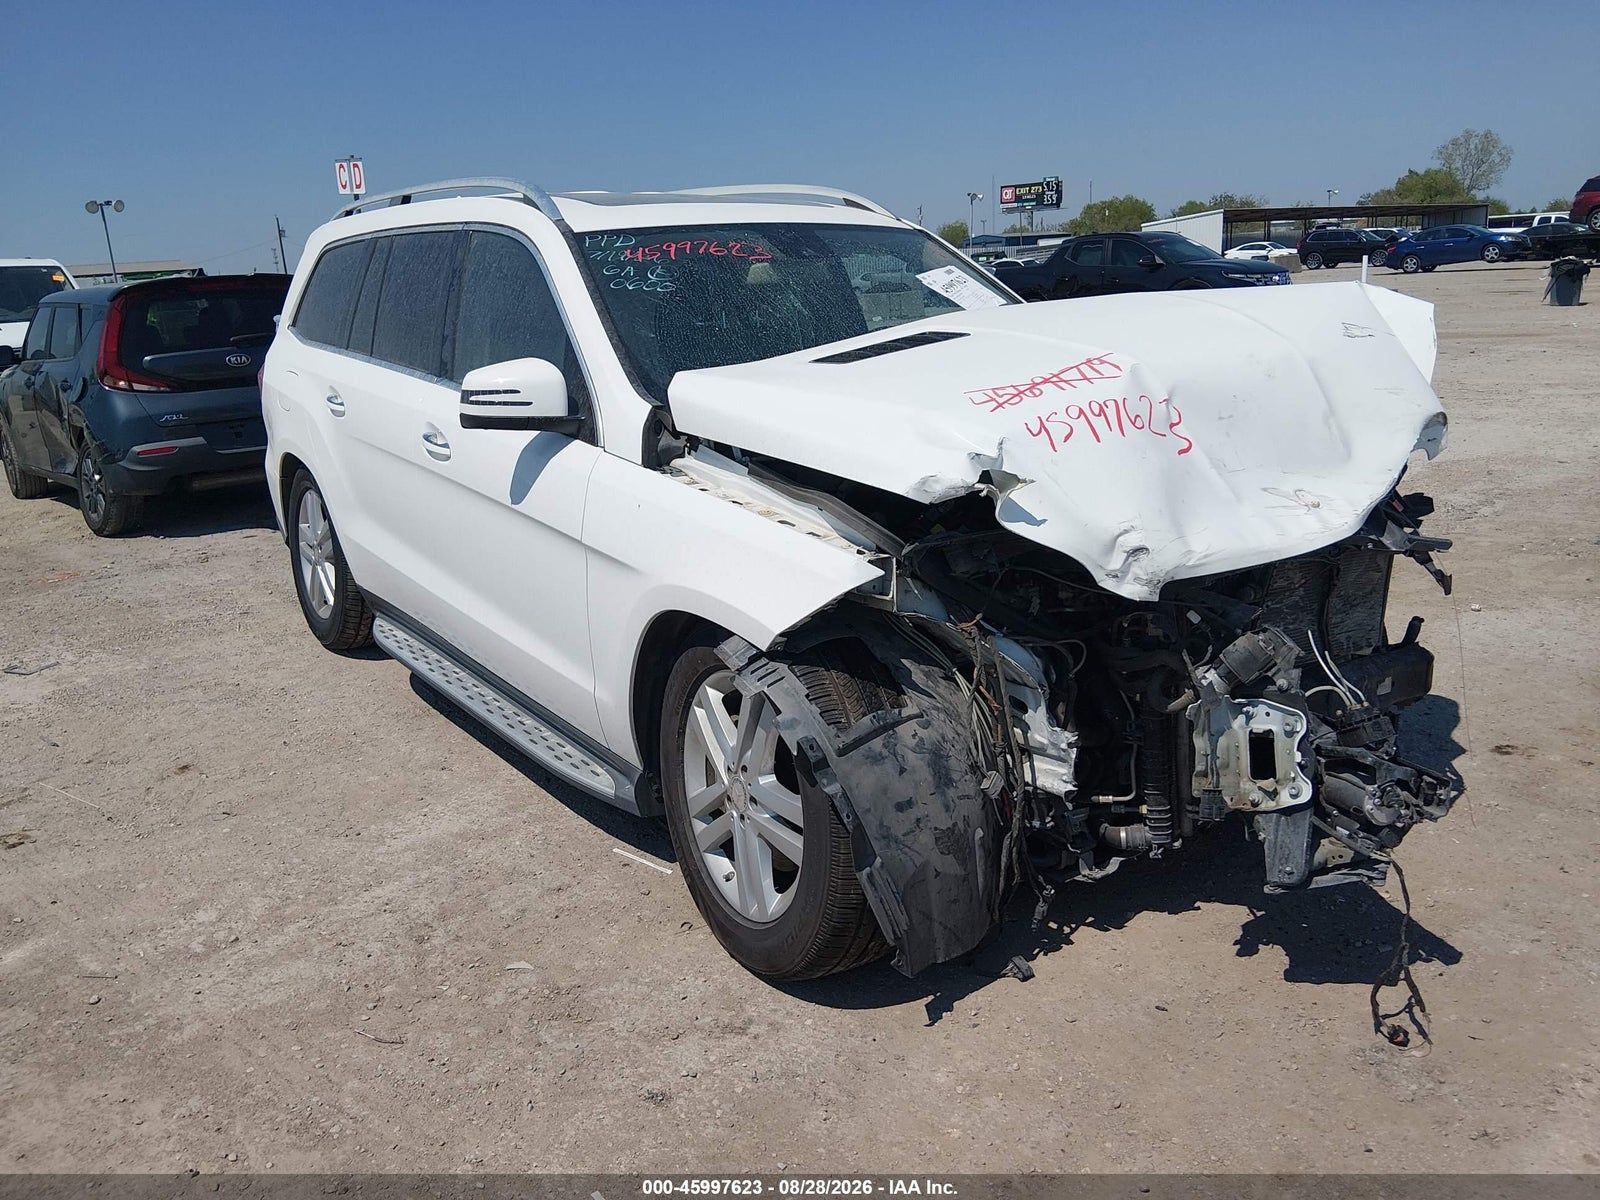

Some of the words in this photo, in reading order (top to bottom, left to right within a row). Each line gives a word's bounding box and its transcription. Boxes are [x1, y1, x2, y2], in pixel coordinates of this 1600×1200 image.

[338, 163, 348, 190] C
[352, 163, 362, 190] D
[1003, 189, 1013, 200] QT
[1016, 187, 1029, 195] EXIT
[625, 240, 772, 263] 45997623
[229, 355, 248, 364] KIA
[1024, 395, 1193, 456] 45997623
